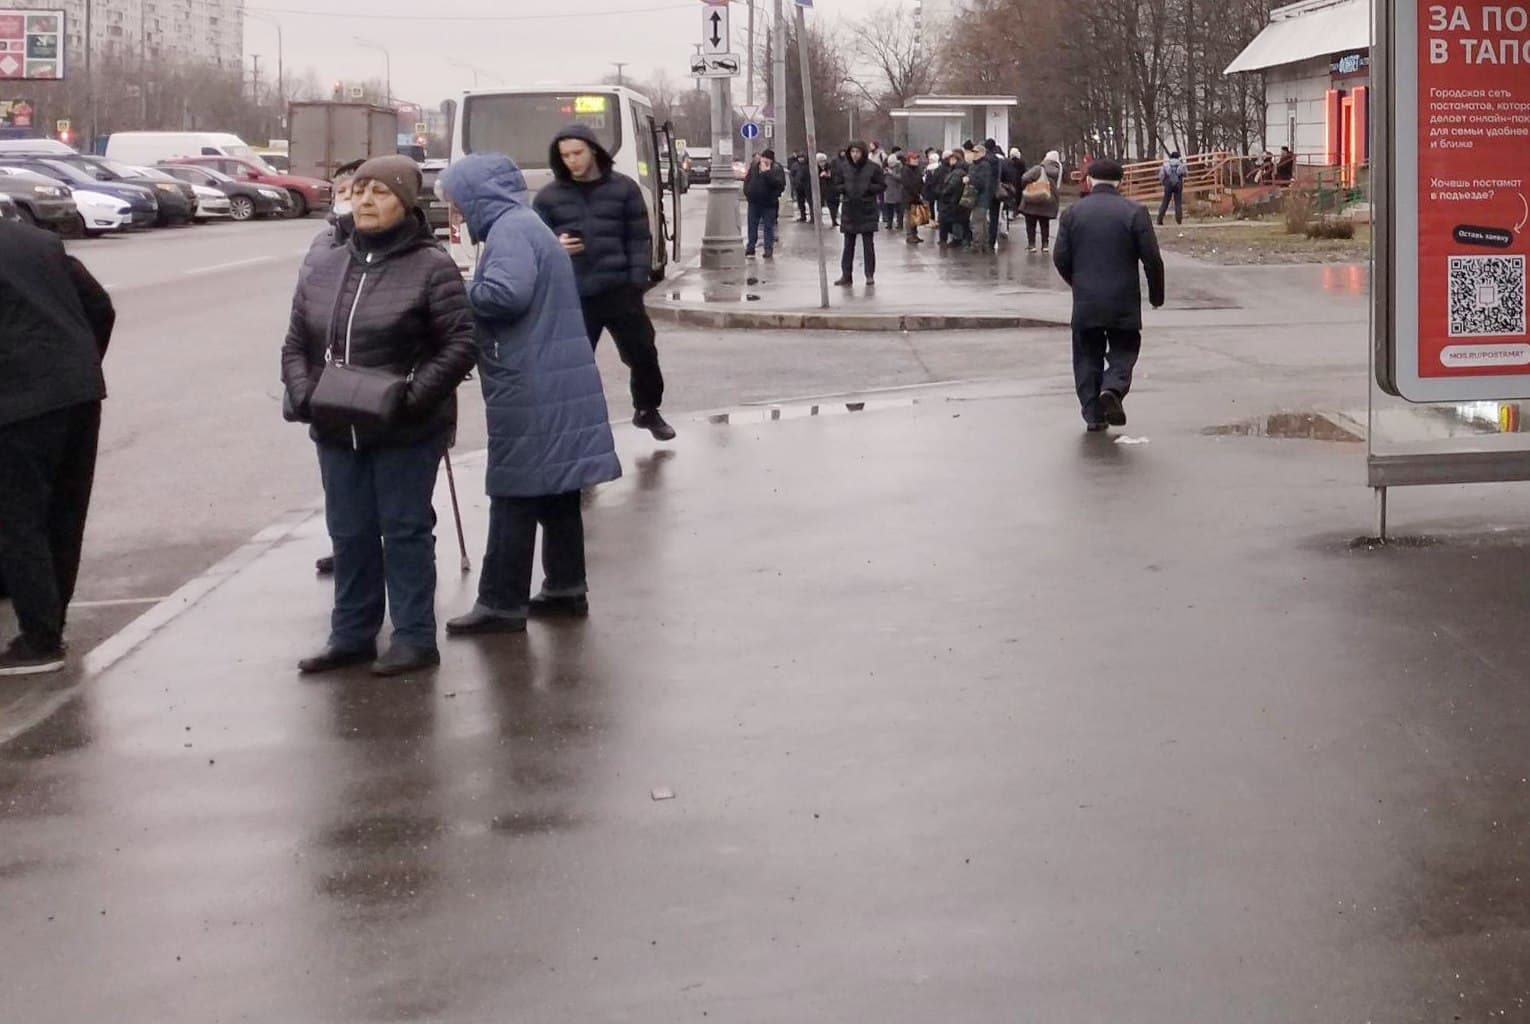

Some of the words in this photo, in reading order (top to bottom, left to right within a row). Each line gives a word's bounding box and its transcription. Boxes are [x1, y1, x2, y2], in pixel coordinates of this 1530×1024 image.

[1428, 5, 1471, 32] ЗА
[1429, 38, 1449, 65] В
[1430, 87, 1486, 99] Городская
[1488, 89, 1512, 98] сеть
[1430, 102, 1495, 112] постаматов,
[1429, 115, 1467, 125] делает
[1429, 127, 1449, 136] для
[1451, 127, 1484, 136] семьи
[1486, 126, 1529, 137] удобнее
[1430, 140, 1438, 148] и
[1440, 138, 1473, 149] ближе
[1430, 177, 1471, 188] Хочешь
[1472, 179, 1522, 188] постамат
[1430, 192, 1438, 200] в
[1439, 189, 1495, 201] подъезде?
